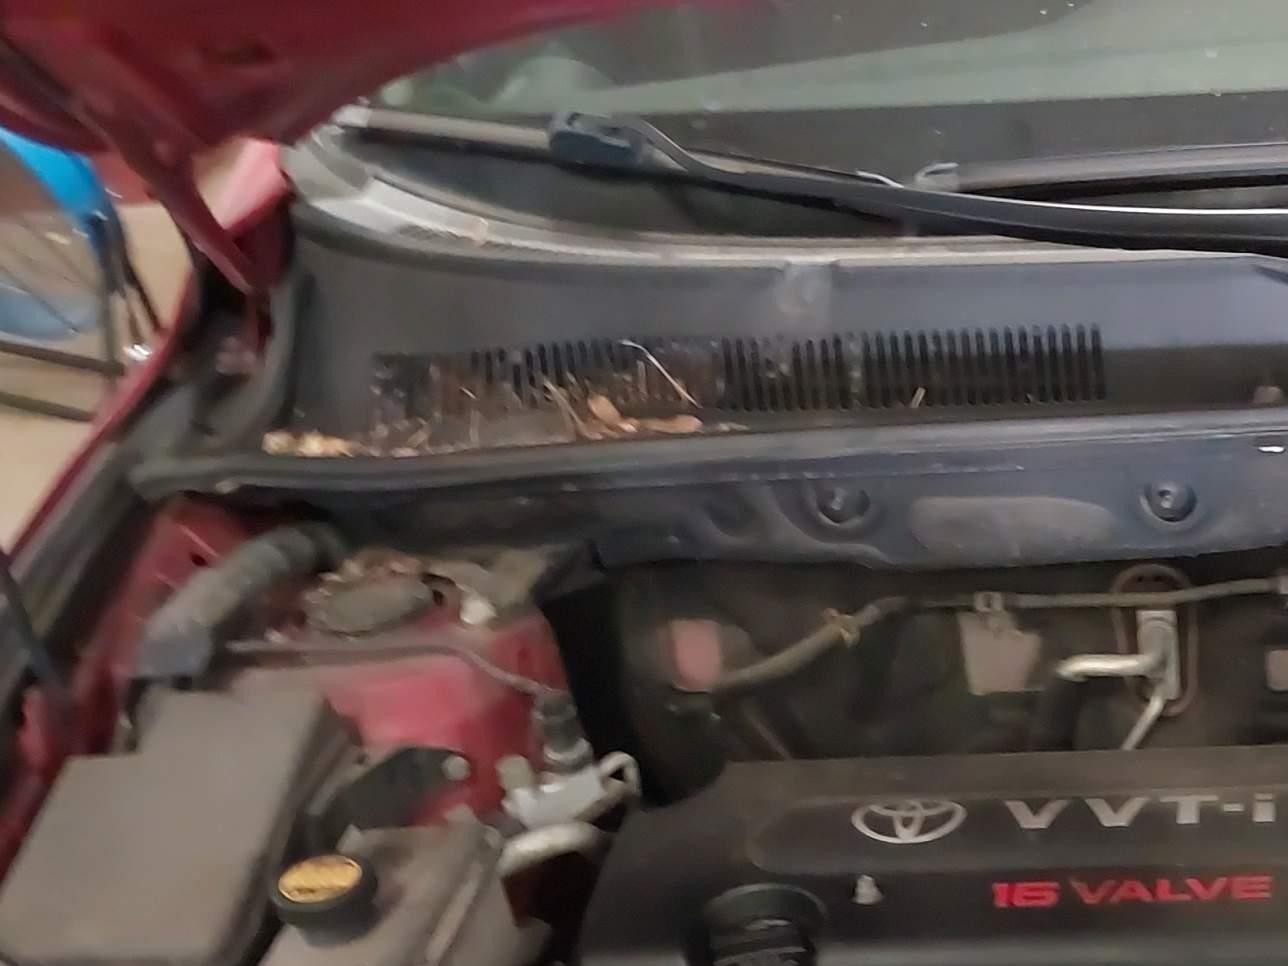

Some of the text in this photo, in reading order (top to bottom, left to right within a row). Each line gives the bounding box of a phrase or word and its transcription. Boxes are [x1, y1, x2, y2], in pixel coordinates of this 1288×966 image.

[1005, 793, 1277, 829] VVT-i
[993, 875, 1273, 908] 16 VALVE
